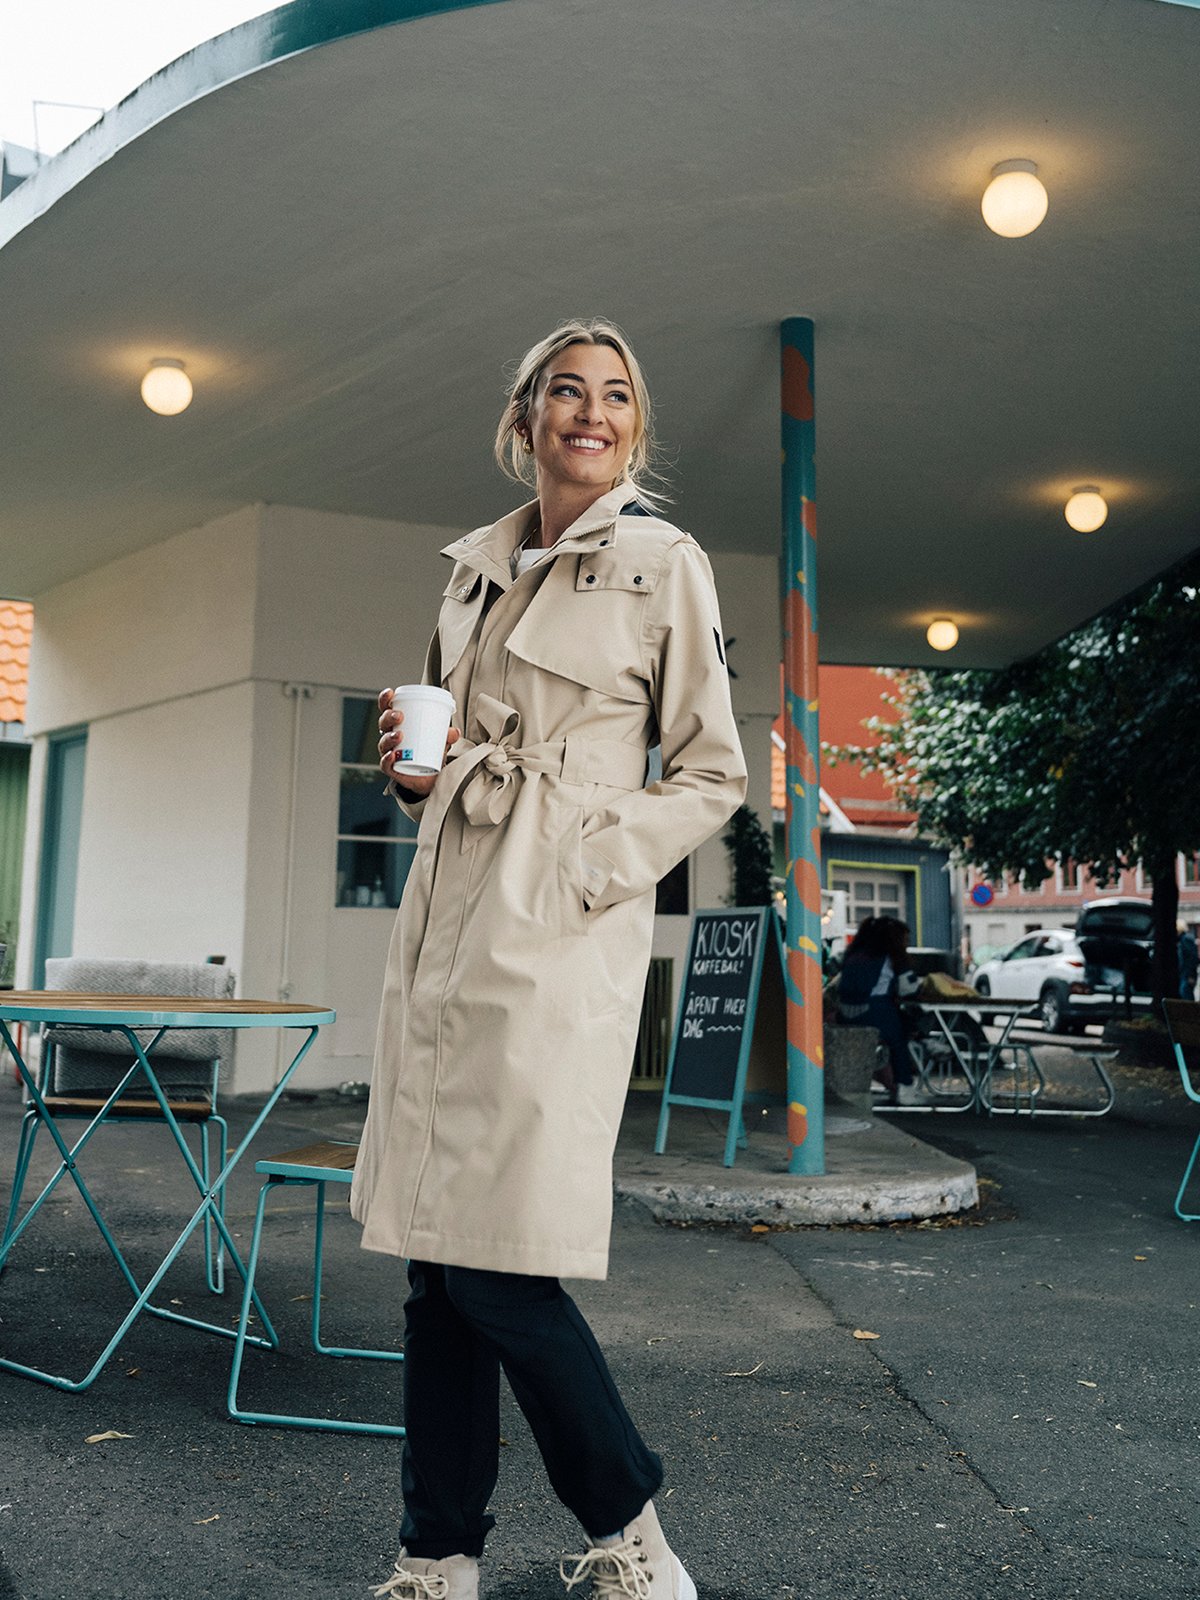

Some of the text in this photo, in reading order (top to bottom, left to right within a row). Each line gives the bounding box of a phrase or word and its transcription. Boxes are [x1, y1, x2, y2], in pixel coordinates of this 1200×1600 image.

[696, 920, 756, 957] KIOSK
[685, 991, 720, 1015] ÅPENT
[682, 1018, 704, 1038] DAG
